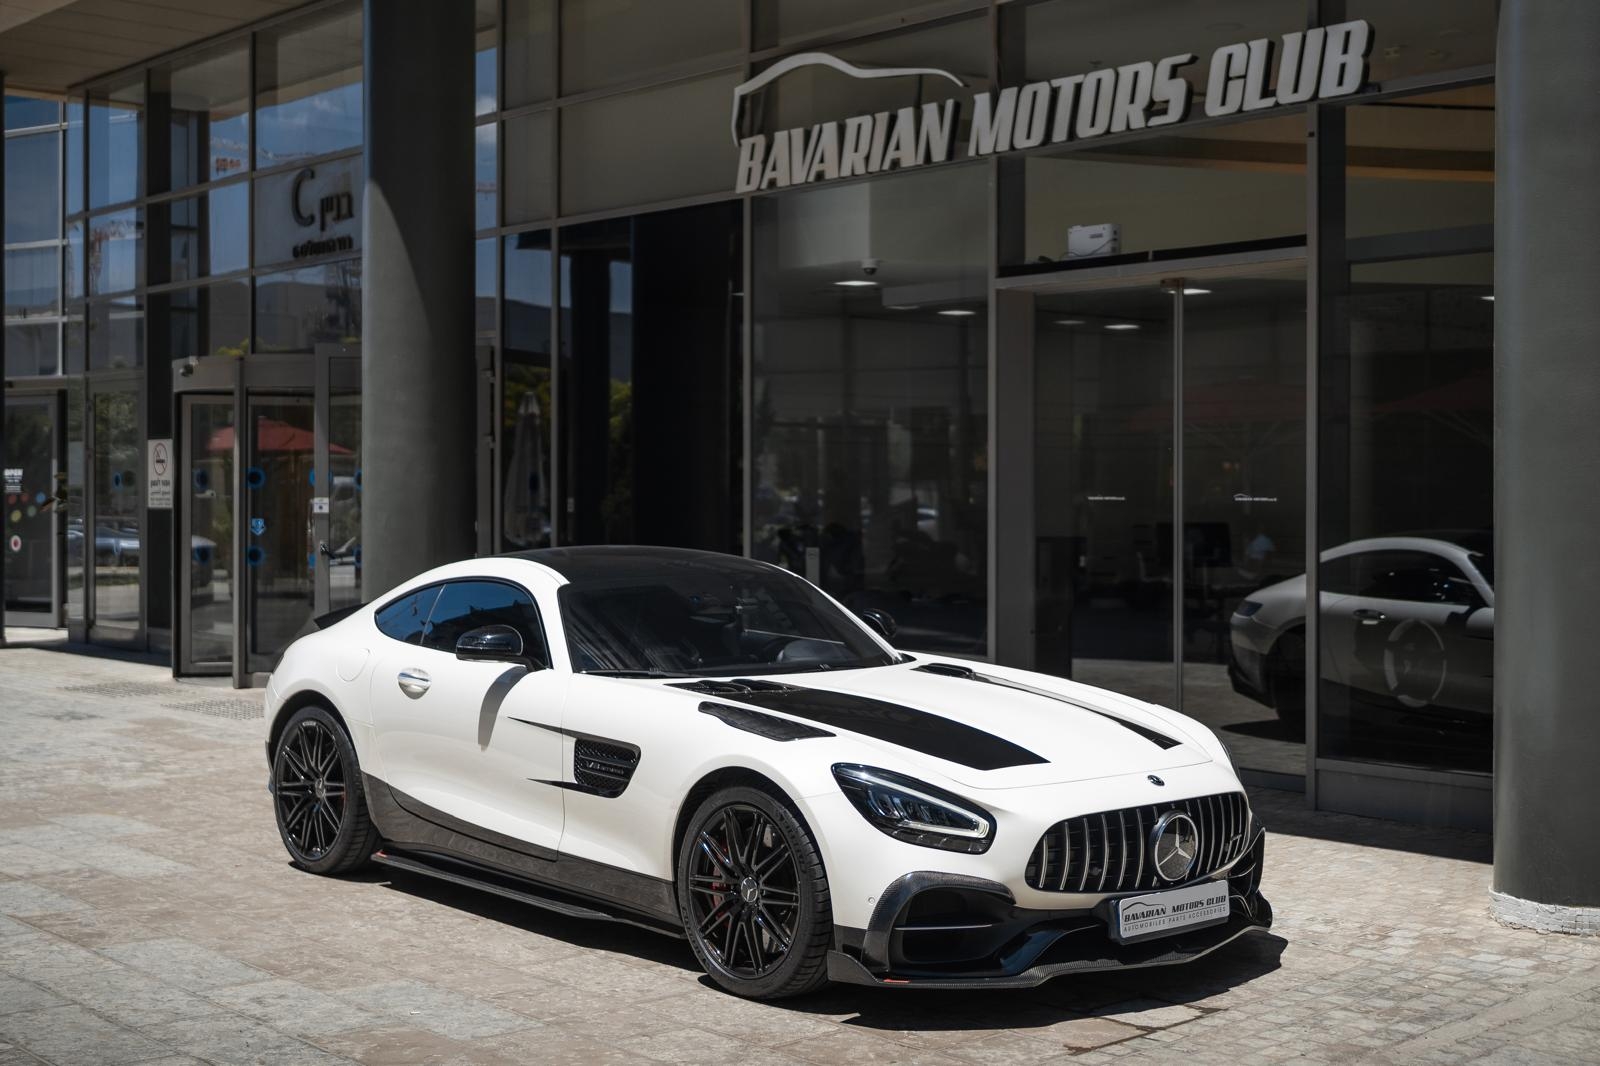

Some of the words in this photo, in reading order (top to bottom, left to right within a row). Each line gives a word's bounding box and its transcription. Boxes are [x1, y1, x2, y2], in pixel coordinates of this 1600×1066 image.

[735, 99, 957, 193] BAVARIAN
[967, 53, 1197, 156] MOTORS
[1205, 20, 1374, 117] CLUB
[292, 168, 316, 227] C
[1124, 907, 1166, 922] BAVARIAN
[1172, 900, 1204, 913] MOTORS
[1206, 895, 1227, 906] CLUB
[1124, 918, 1166, 932] AUTOMOBILES
[1169, 915, 1186, 924] PARTS
[1188, 906, 1226, 919] ACCESSORIES
